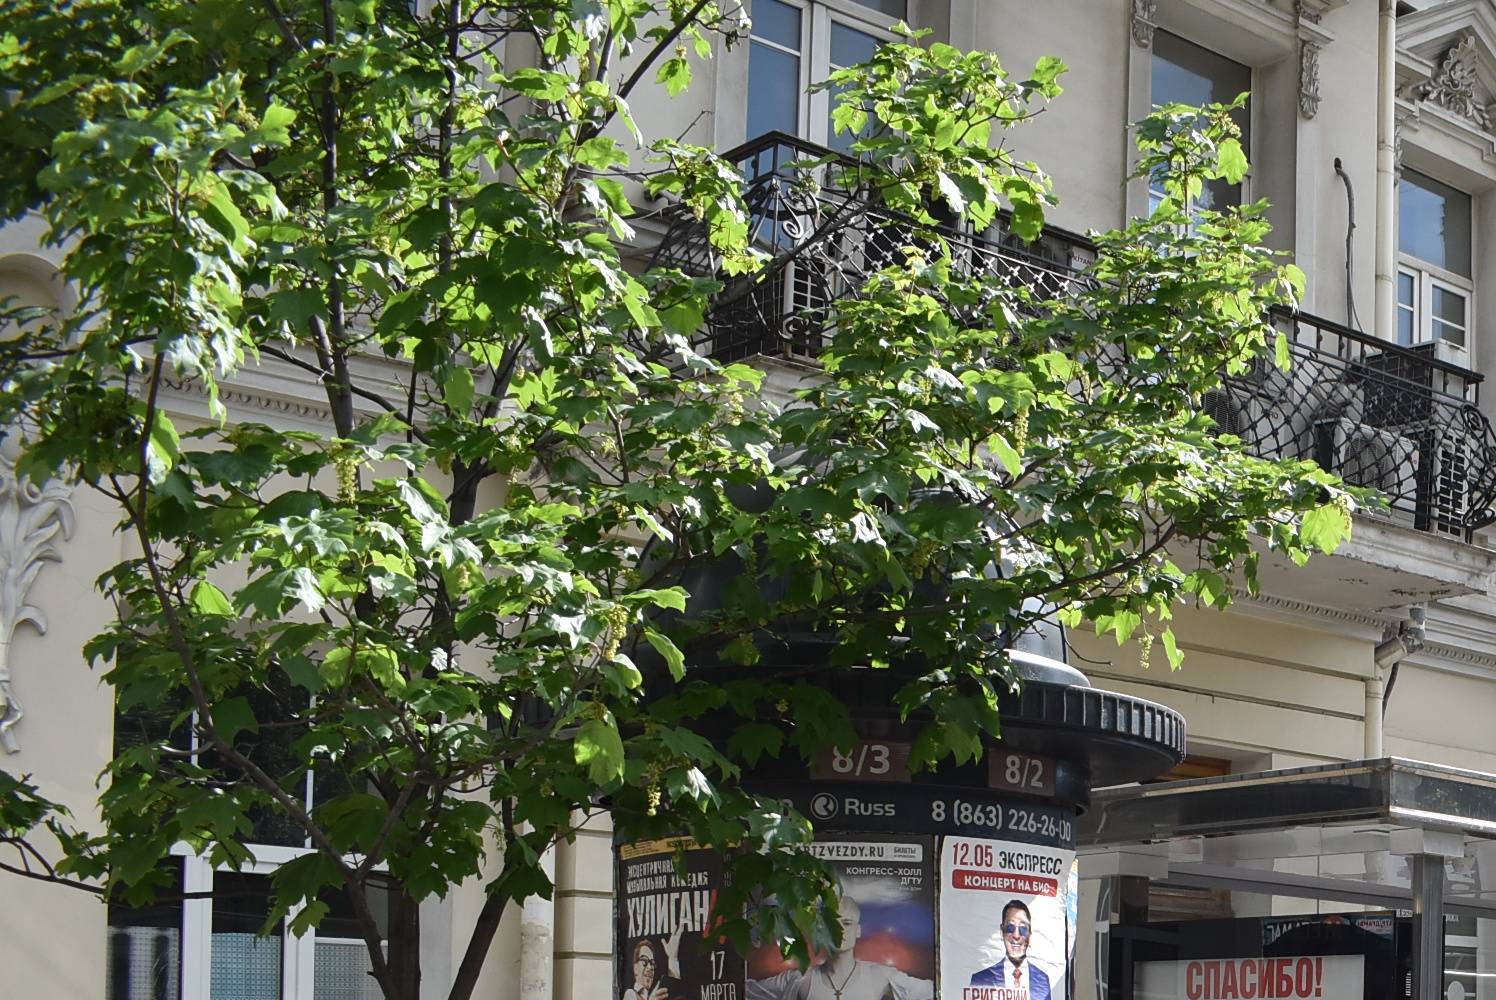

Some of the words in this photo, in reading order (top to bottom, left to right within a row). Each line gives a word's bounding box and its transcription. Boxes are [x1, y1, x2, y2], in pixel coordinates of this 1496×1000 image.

[832, 744, 891, 776] 8/3
[1005, 755, 1043, 788] 8/2
[845, 798, 895, 816] Russ
[932, 800, 946, 822] 8
[954, 799, 1002, 830] (863)
[1008, 808, 1071, 842] 226-26-00
[802, 845, 885, 858] RTZVEZDY.RU
[953, 842, 993, 868] 12.05
[999, 851, 1062, 875] ЭКСПРЕСС
[846, 867, 922, 877] КОНГРЕСС-ХОЛЛ
[901, 877, 922, 886] ДГТУ
[964, 875, 1015, 889] КОНЦЕРТ
[1018, 880, 1031, 891] НА
[1032, 882, 1050, 893] БИС
[710, 950, 726, 980] 17
[1186, 957, 1323, 1000] СПАСИБО!
